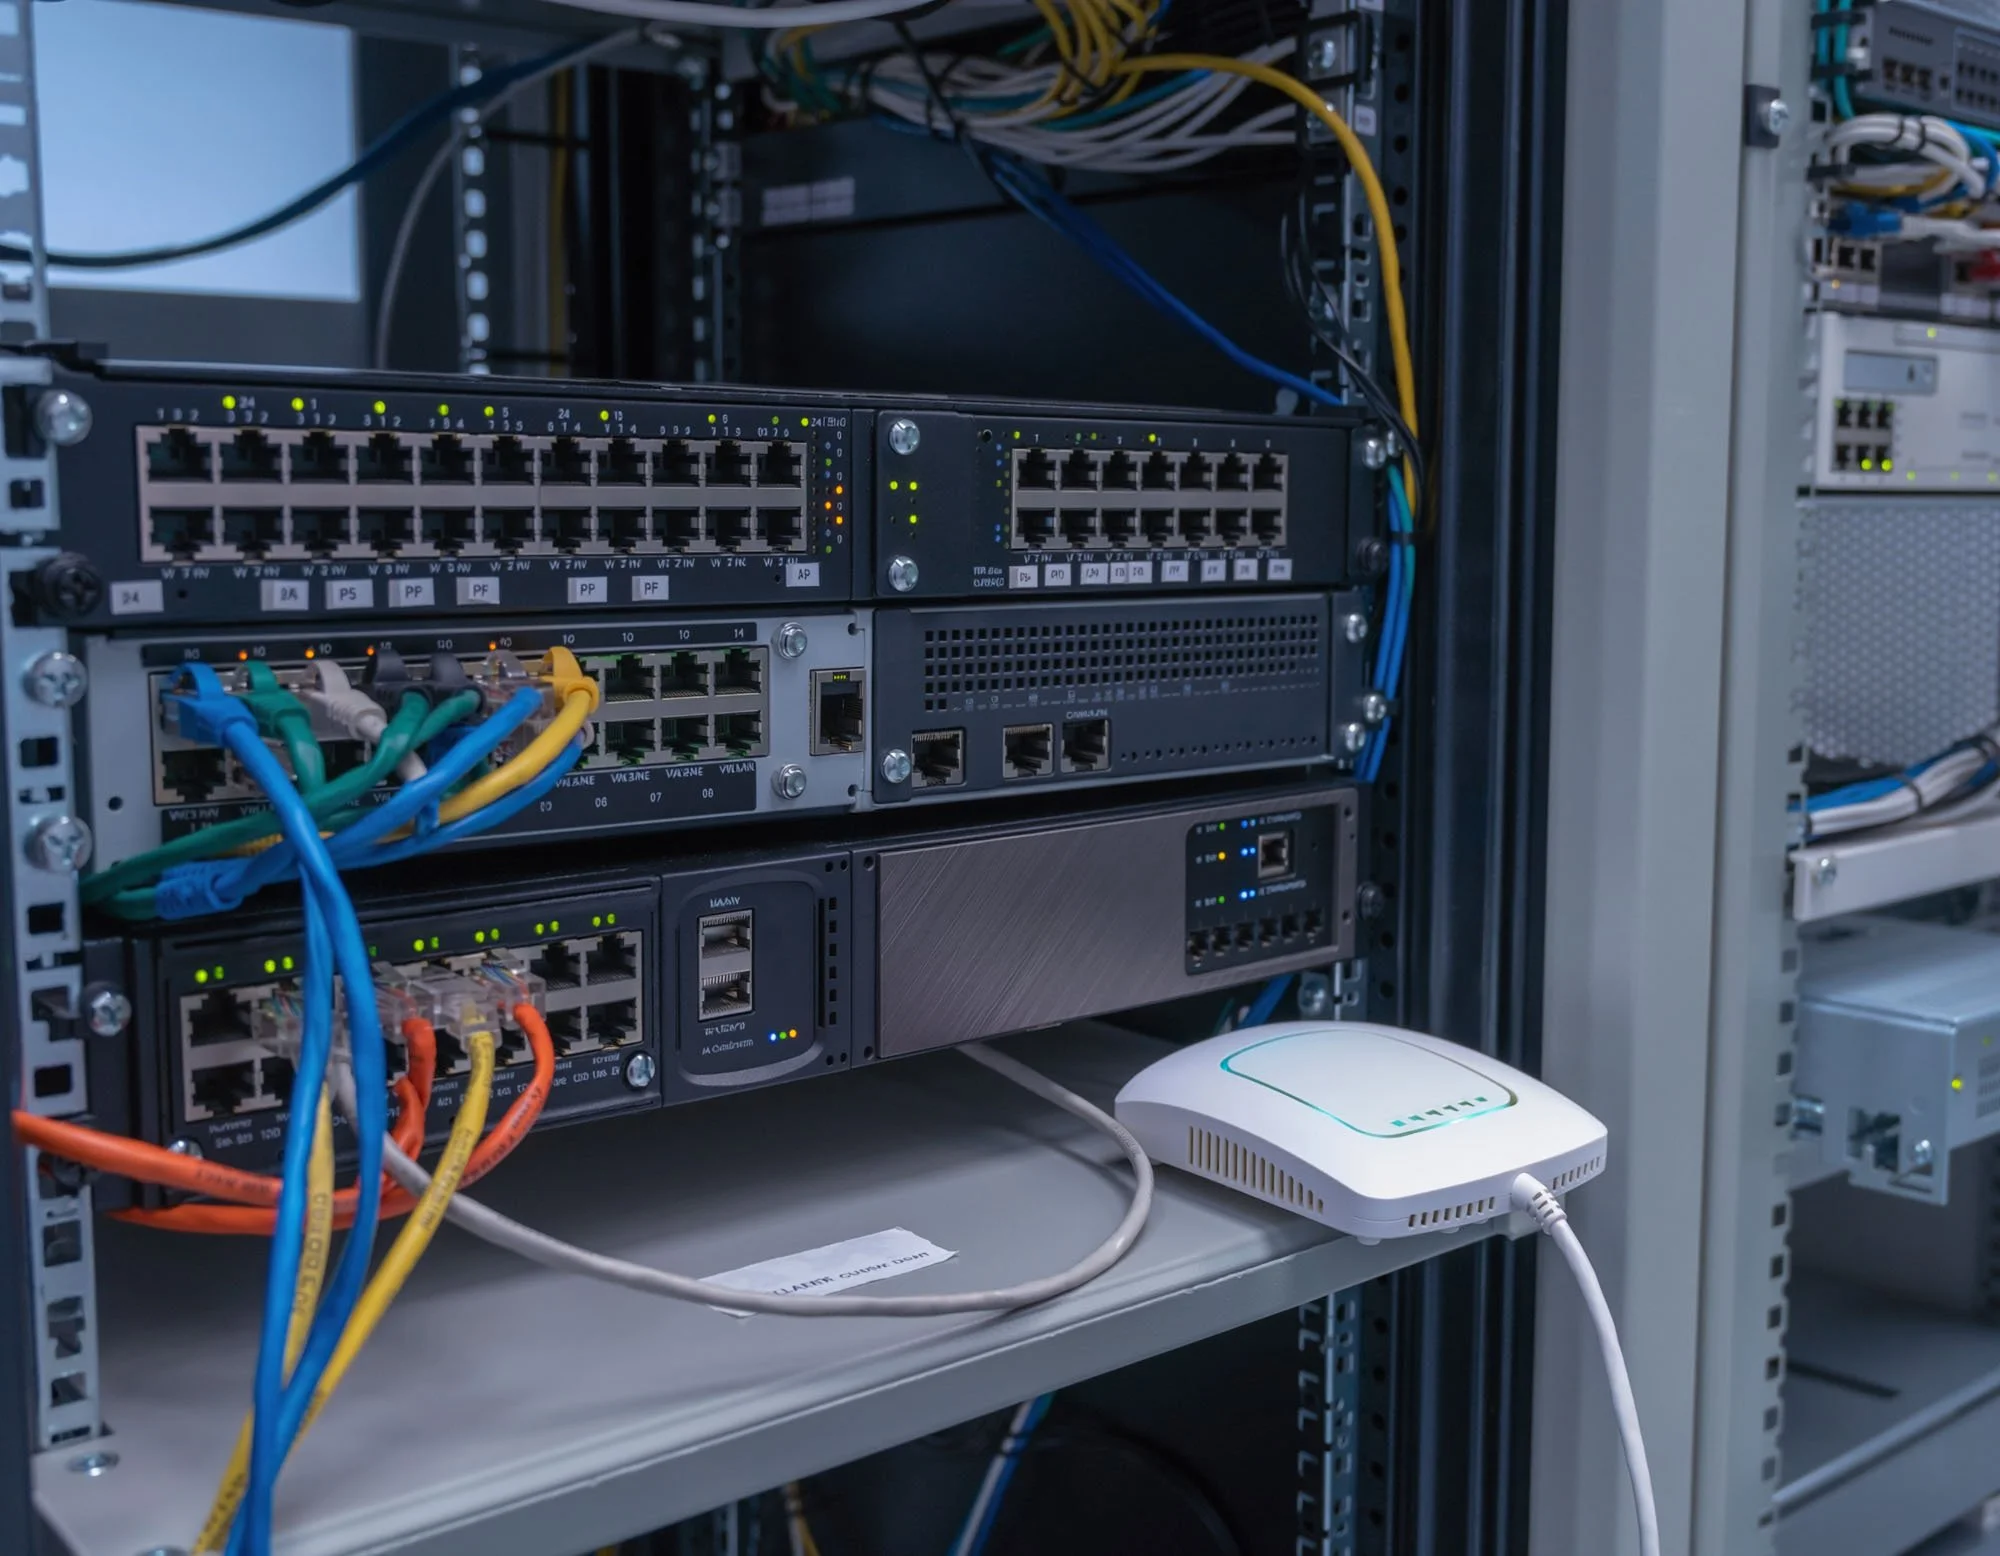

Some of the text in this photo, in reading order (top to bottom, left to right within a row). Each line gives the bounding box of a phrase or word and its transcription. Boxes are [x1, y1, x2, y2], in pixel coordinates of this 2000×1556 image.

[558, 408, 570, 420] 24
[798, 569, 811, 580] AP
[562, 633, 575, 645] 10
[622, 632, 634, 643] 10
[679, 629, 690, 641] 10
[650, 792, 662, 803] 07
